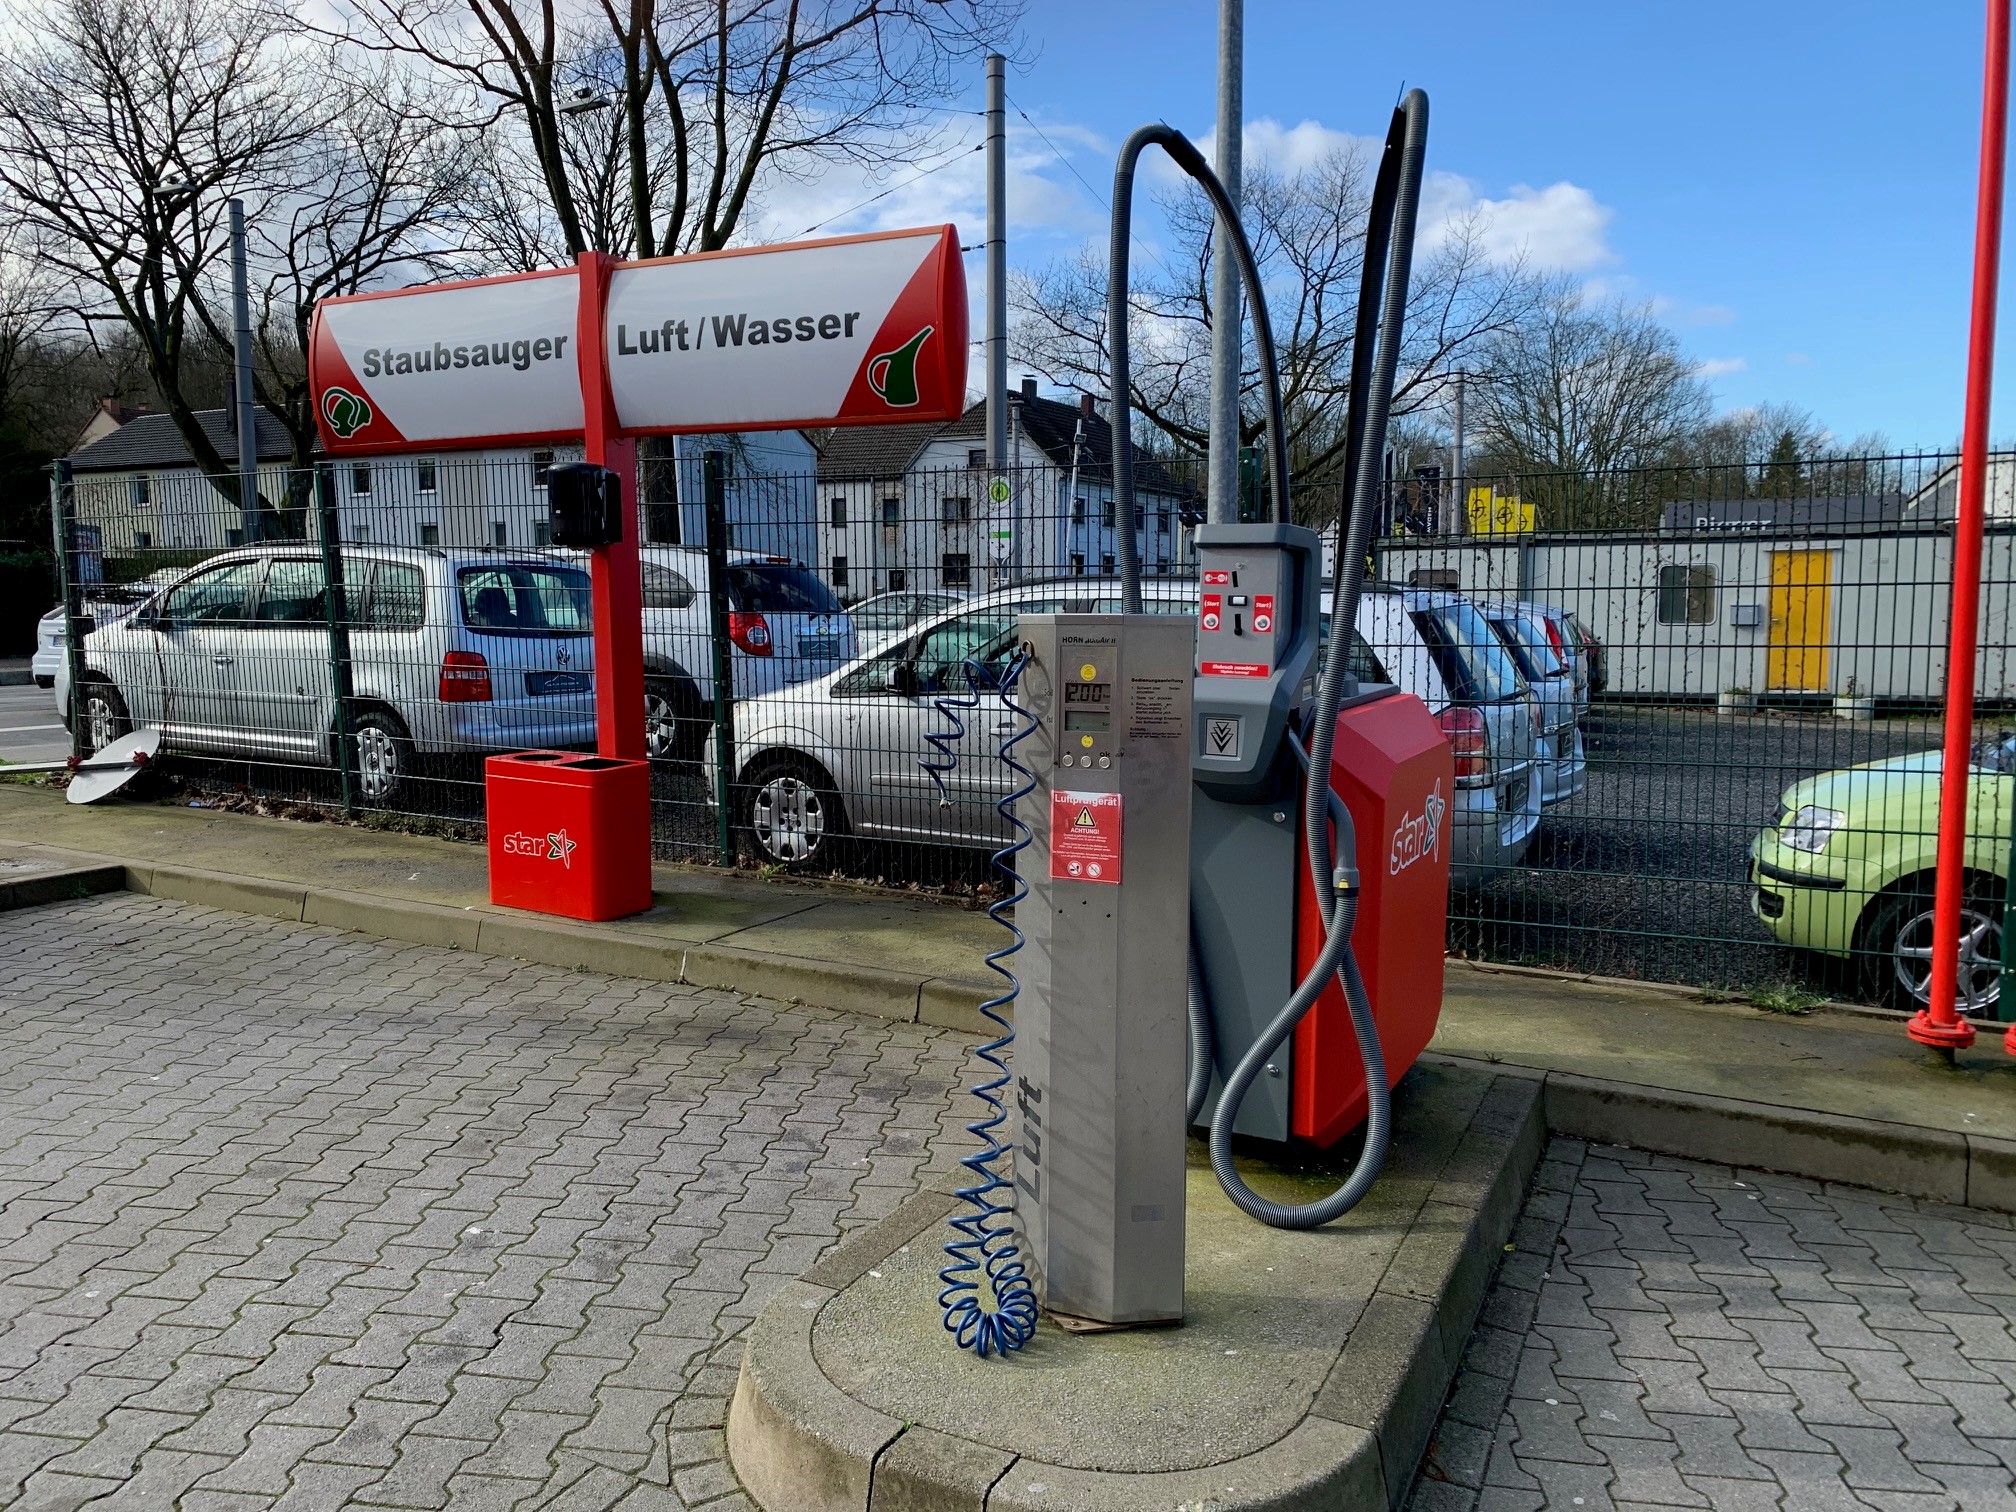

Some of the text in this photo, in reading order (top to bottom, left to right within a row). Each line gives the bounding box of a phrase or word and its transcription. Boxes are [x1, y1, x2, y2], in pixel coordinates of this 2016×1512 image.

[362, 332, 568, 378] Staubsauger
[1062, 636, 1084, 644] HORN
[1068, 684, 1102, 702] 2.00
[503, 831, 545, 856] star
[1390, 810, 1425, 876] star
[1016, 1075, 1042, 1205] Luft
